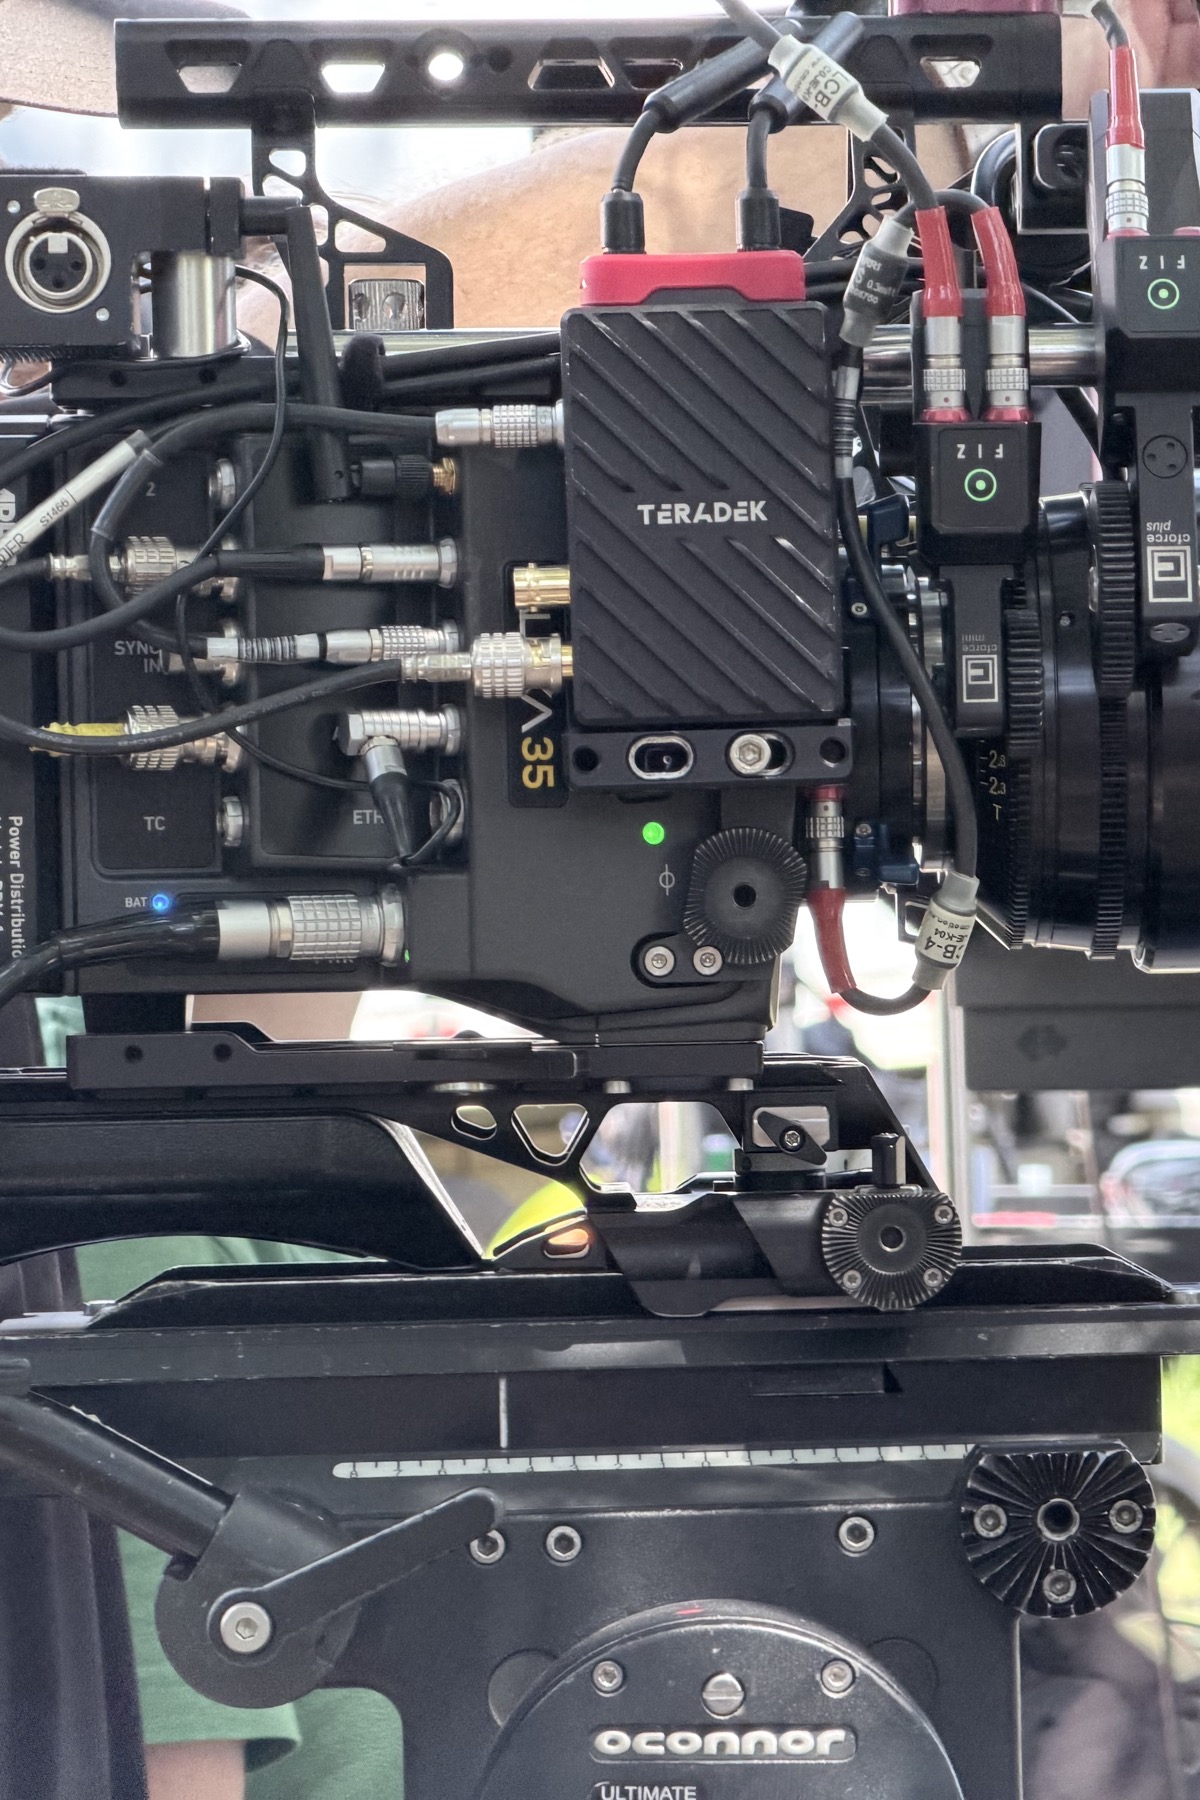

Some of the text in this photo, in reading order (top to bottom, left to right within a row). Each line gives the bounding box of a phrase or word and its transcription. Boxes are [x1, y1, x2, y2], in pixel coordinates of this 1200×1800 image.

[145, 481, 156, 497] 2
[39, 498, 70, 527] S1466
[636, 500, 769, 526] TERADEK
[1146, 520, 1172, 533] plus
[1146, 533, 1191, 545] cforce
[521, 736, 555, 789] 35
[144, 816, 166, 831] TC
[8, 816, 23, 868] Power
[125, 897, 147, 909] BAT
[594, 1729, 846, 1756] oconnor
[601, 1785, 697, 1800] ULTIMATE
